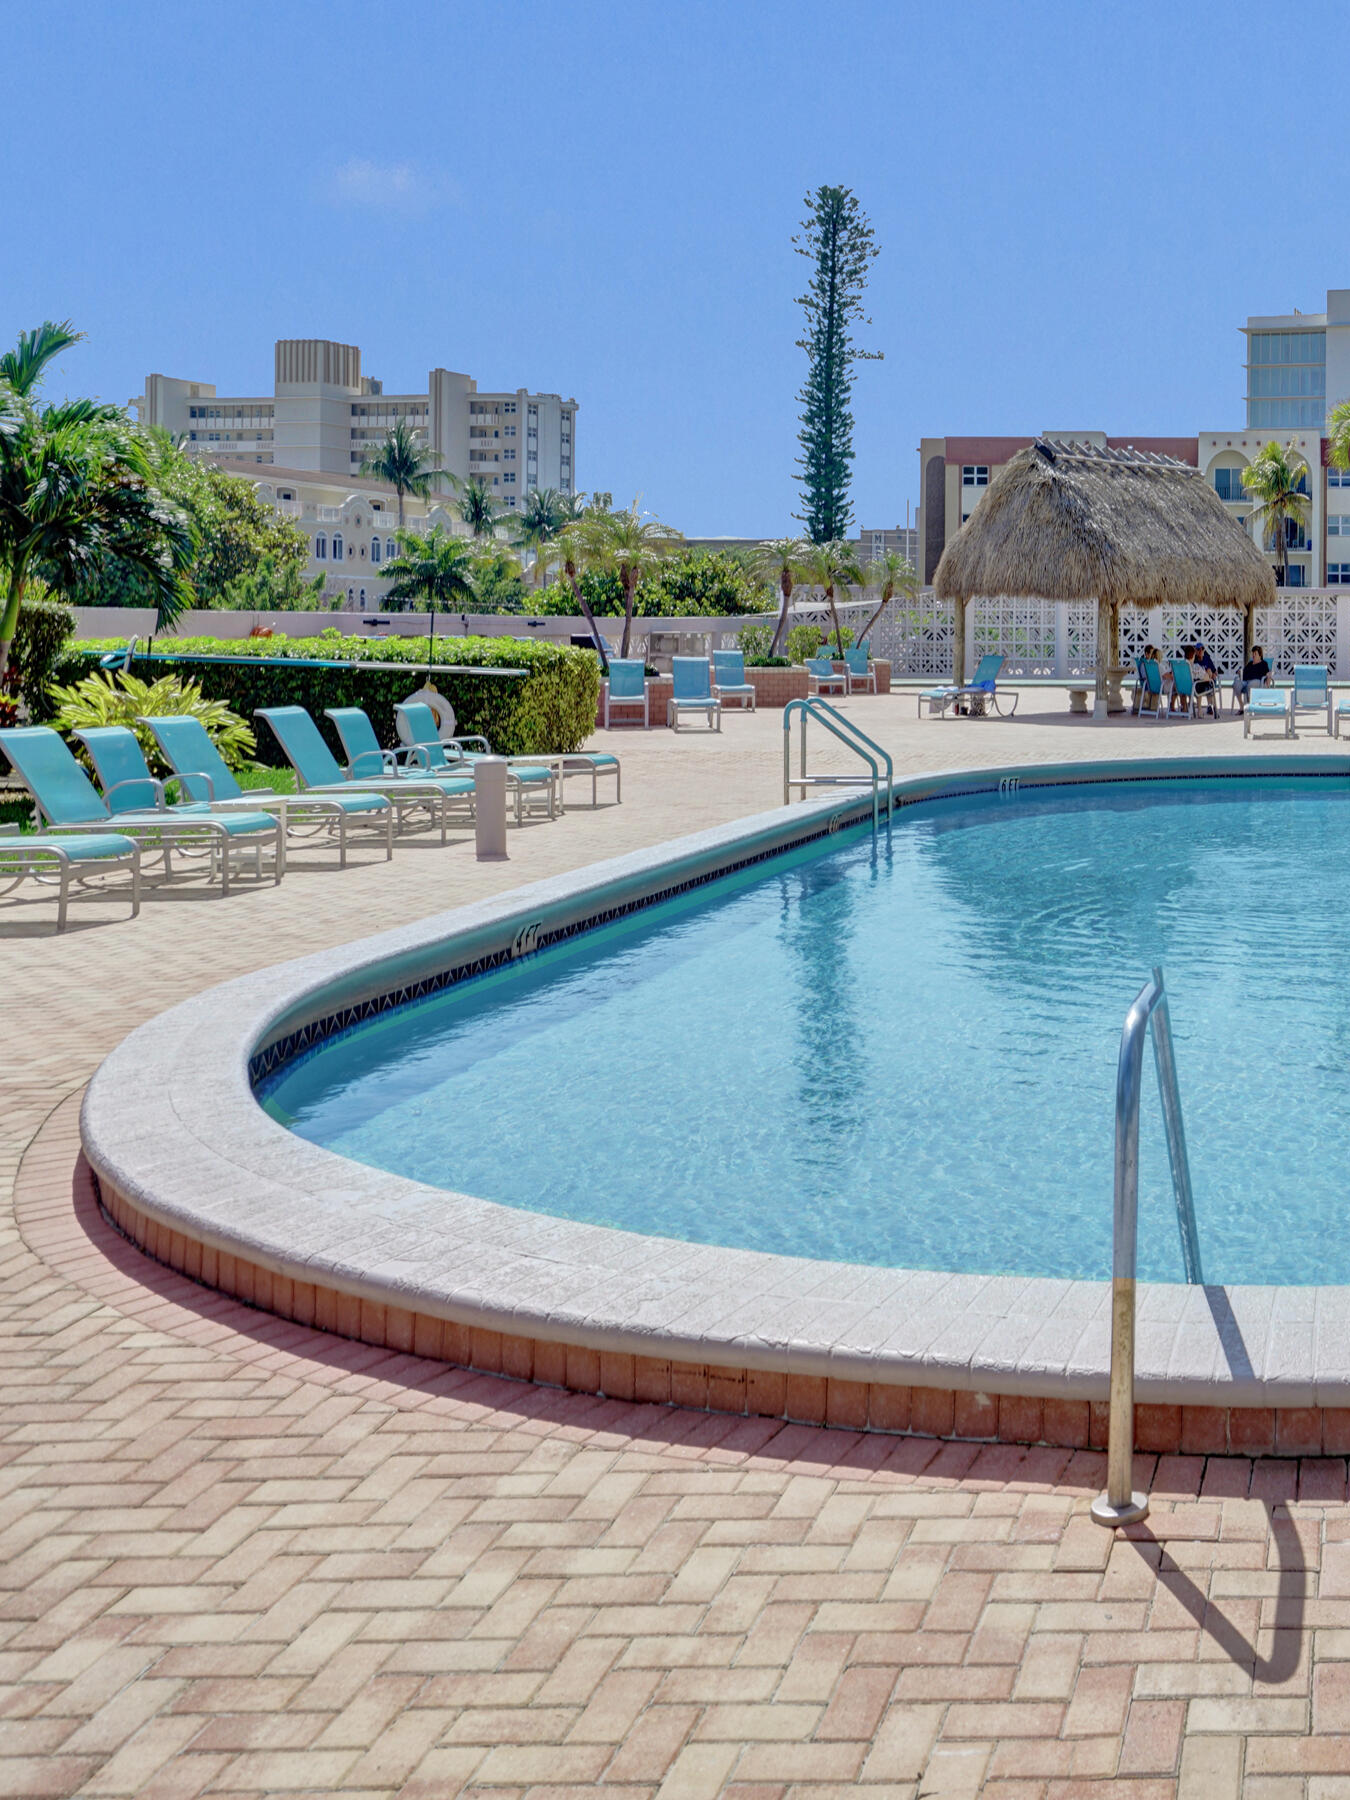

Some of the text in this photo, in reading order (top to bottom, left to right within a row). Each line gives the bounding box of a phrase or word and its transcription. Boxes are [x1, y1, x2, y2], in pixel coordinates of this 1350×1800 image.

[1008, 778, 1019, 792] FT
[516, 922, 542, 953] 4 FT
